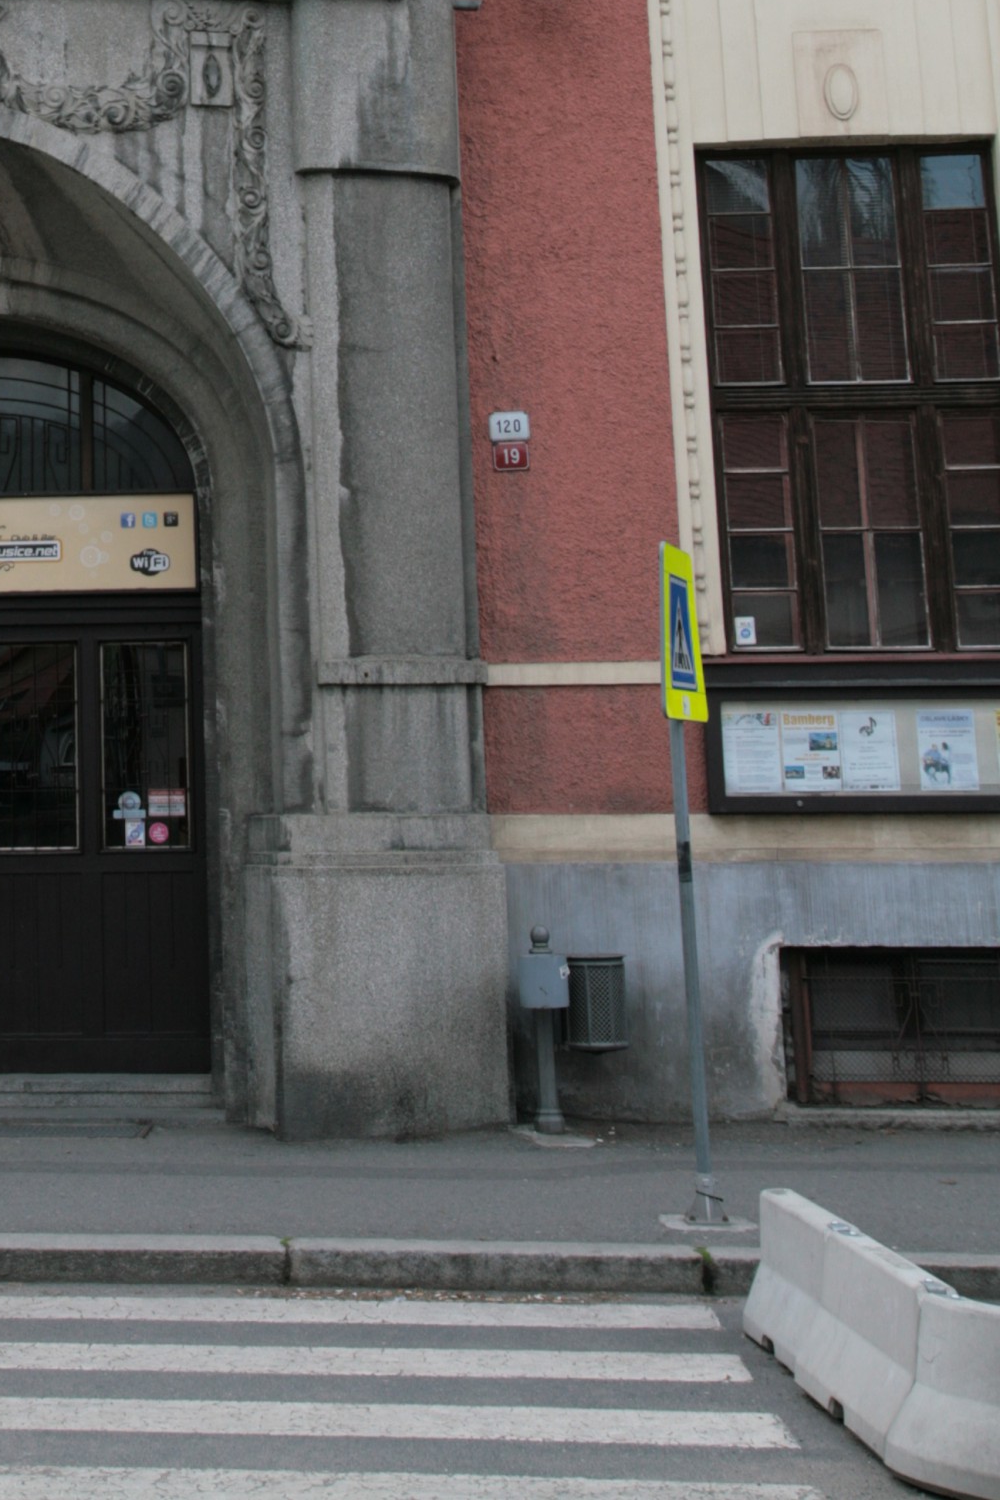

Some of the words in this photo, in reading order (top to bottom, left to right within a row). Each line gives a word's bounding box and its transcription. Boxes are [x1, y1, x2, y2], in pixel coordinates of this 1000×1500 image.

[496, 418, 521, 433] 120
[503, 448, 520, 465] 19
[783, 713, 835, 726] Bamberg
